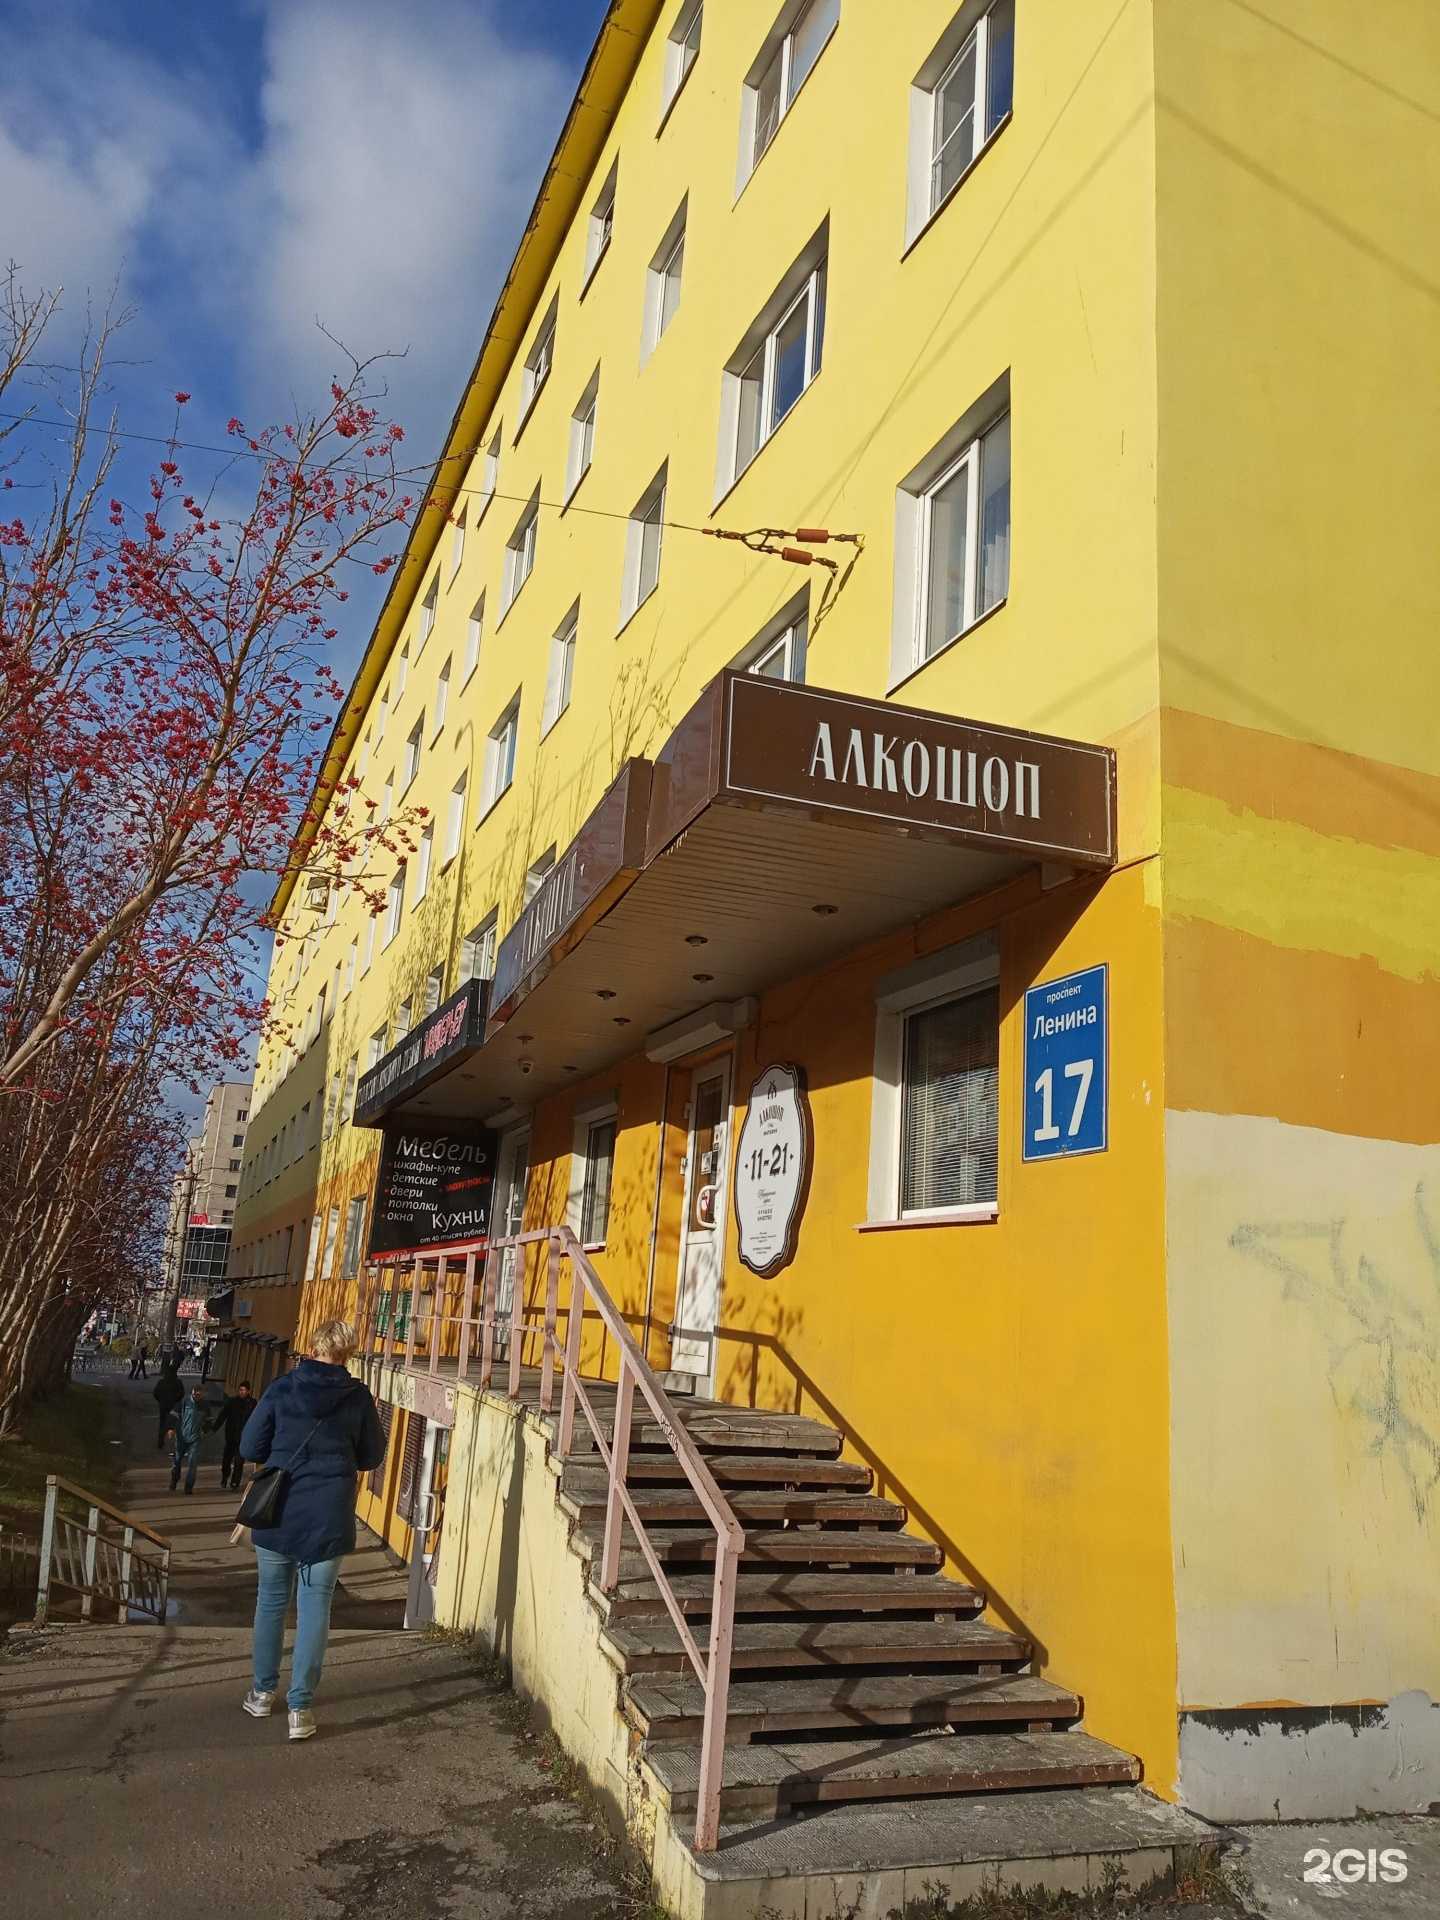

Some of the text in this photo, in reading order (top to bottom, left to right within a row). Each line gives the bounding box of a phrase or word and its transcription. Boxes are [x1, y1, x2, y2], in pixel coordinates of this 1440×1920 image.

[808, 721, 1041, 820] АЛКОШОП
[1046, 984, 1082, 1005] проспект
[1033, 1004, 1097, 1040] Ленина
[1034, 1058, 1094, 1142] 17
[396, 1136, 487, 1164] Мебель
[393, 1160, 461, 1176] шкафы-купе
[750, 1142, 789, 1181] 11-21
[392, 1172, 438, 1186] детские
[390, 1185, 423, 1200] двери
[388, 1199, 438, 1211] потолки
[387, 1211, 414, 1222] окна
[463, 1227, 486, 1239] рублей
